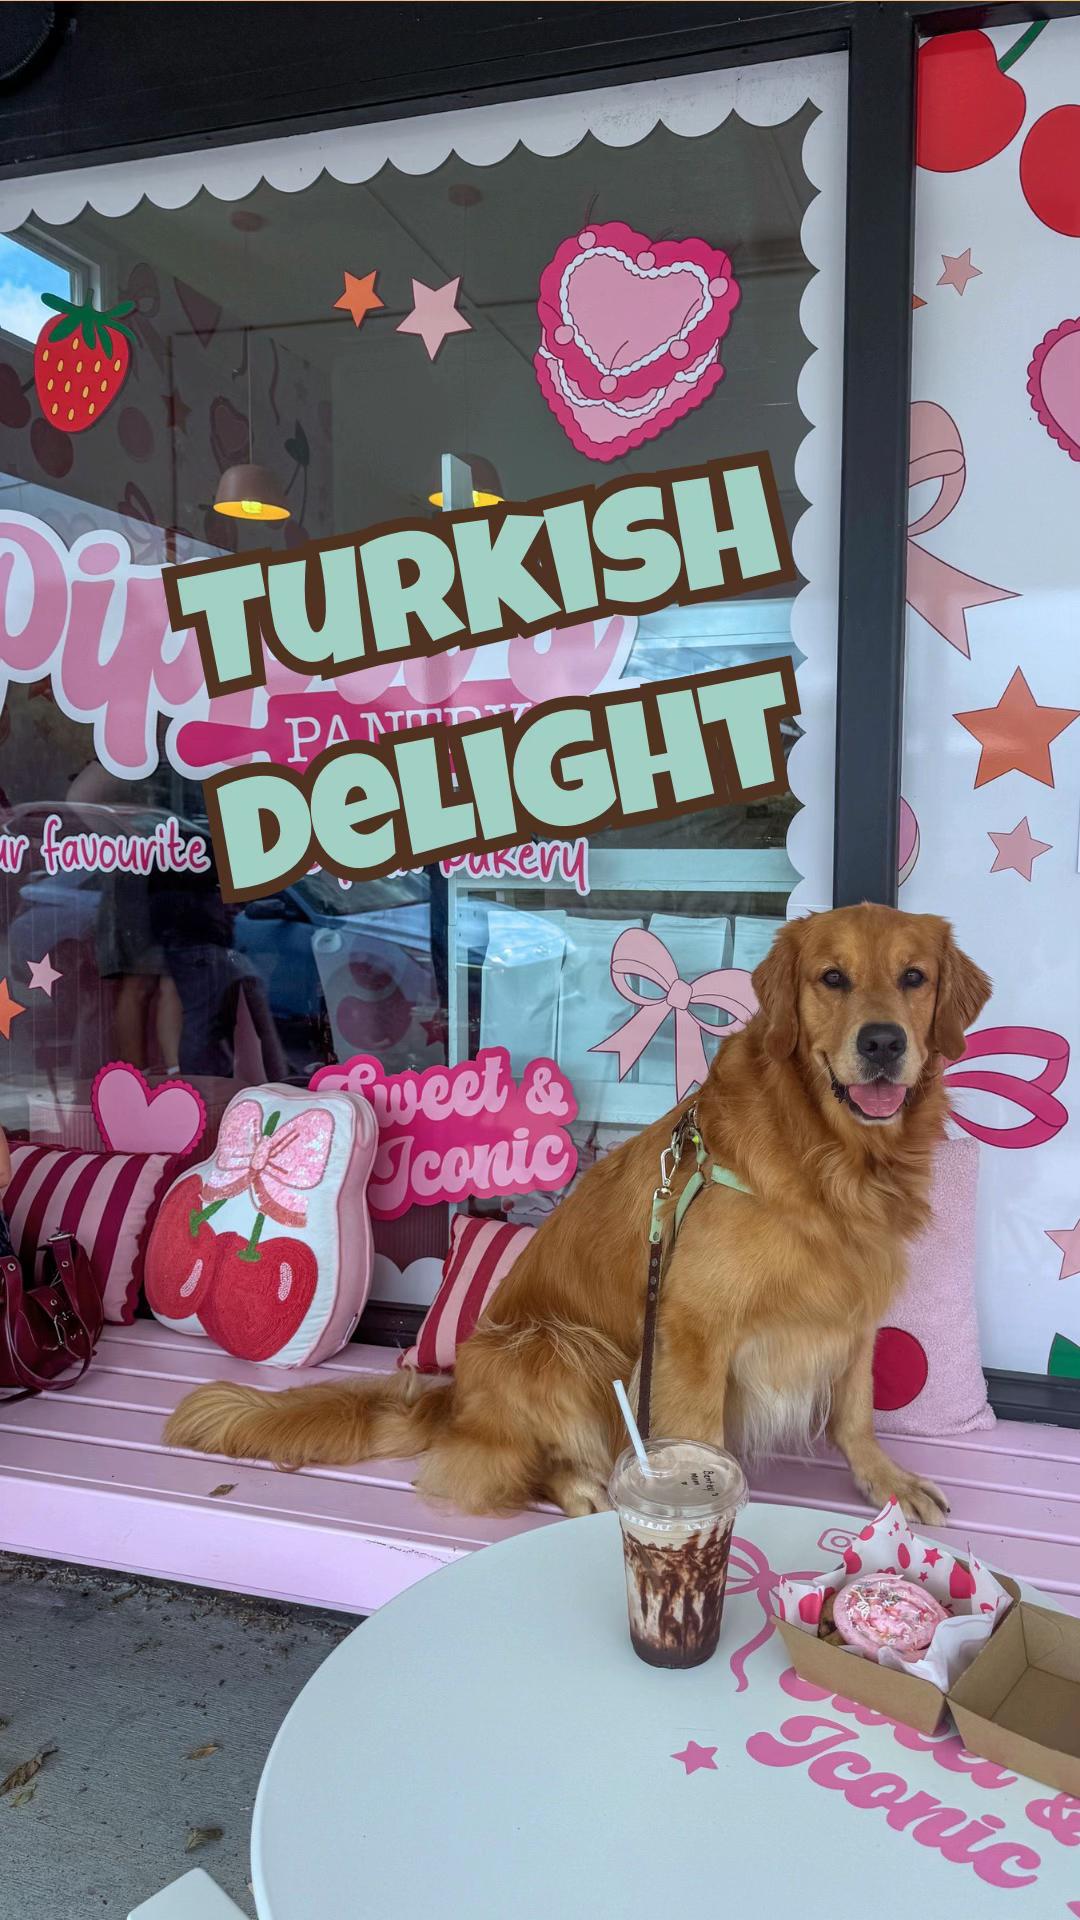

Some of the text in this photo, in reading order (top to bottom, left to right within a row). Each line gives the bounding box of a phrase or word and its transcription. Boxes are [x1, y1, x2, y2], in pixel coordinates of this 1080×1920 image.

[42, 817, 209, 872] favourite
[525, 1066, 570, 1117] &
[366, 1127, 570, 1211] Iconic
[744, 1715, 1042, 1889] Iconic
